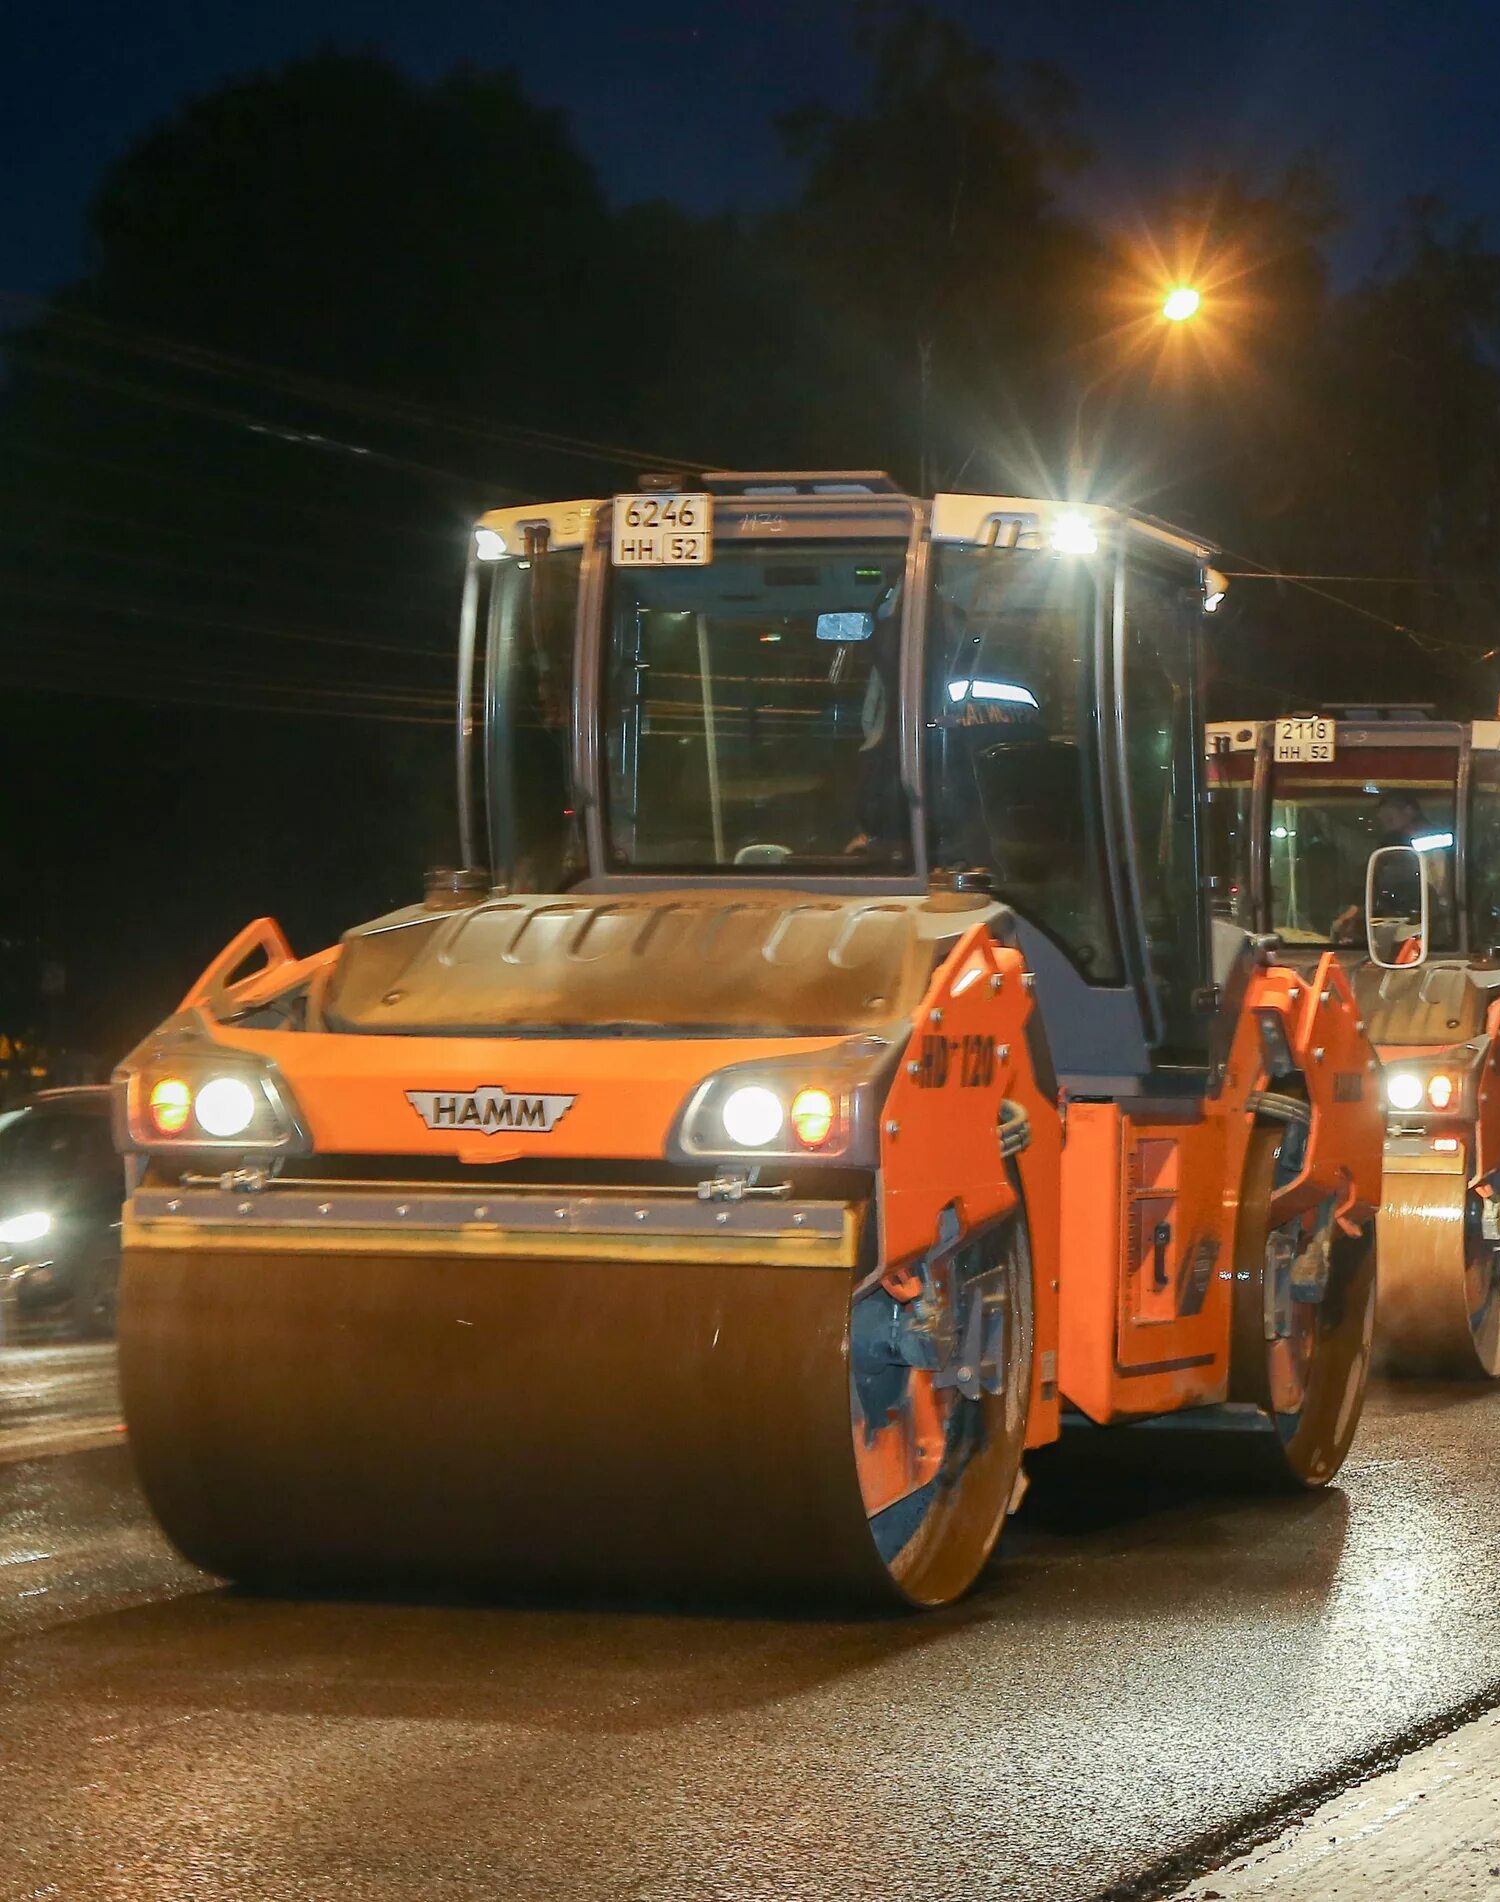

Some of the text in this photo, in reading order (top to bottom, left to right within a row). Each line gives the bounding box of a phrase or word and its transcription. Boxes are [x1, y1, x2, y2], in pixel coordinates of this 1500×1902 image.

[625, 500, 695, 528] 6246
[621, 539, 698, 560] HH 52
[1282, 723, 1326, 739] 2118
[1279, 746, 1328, 759] HH 52
[432, 1097, 546, 1127] HAMM
